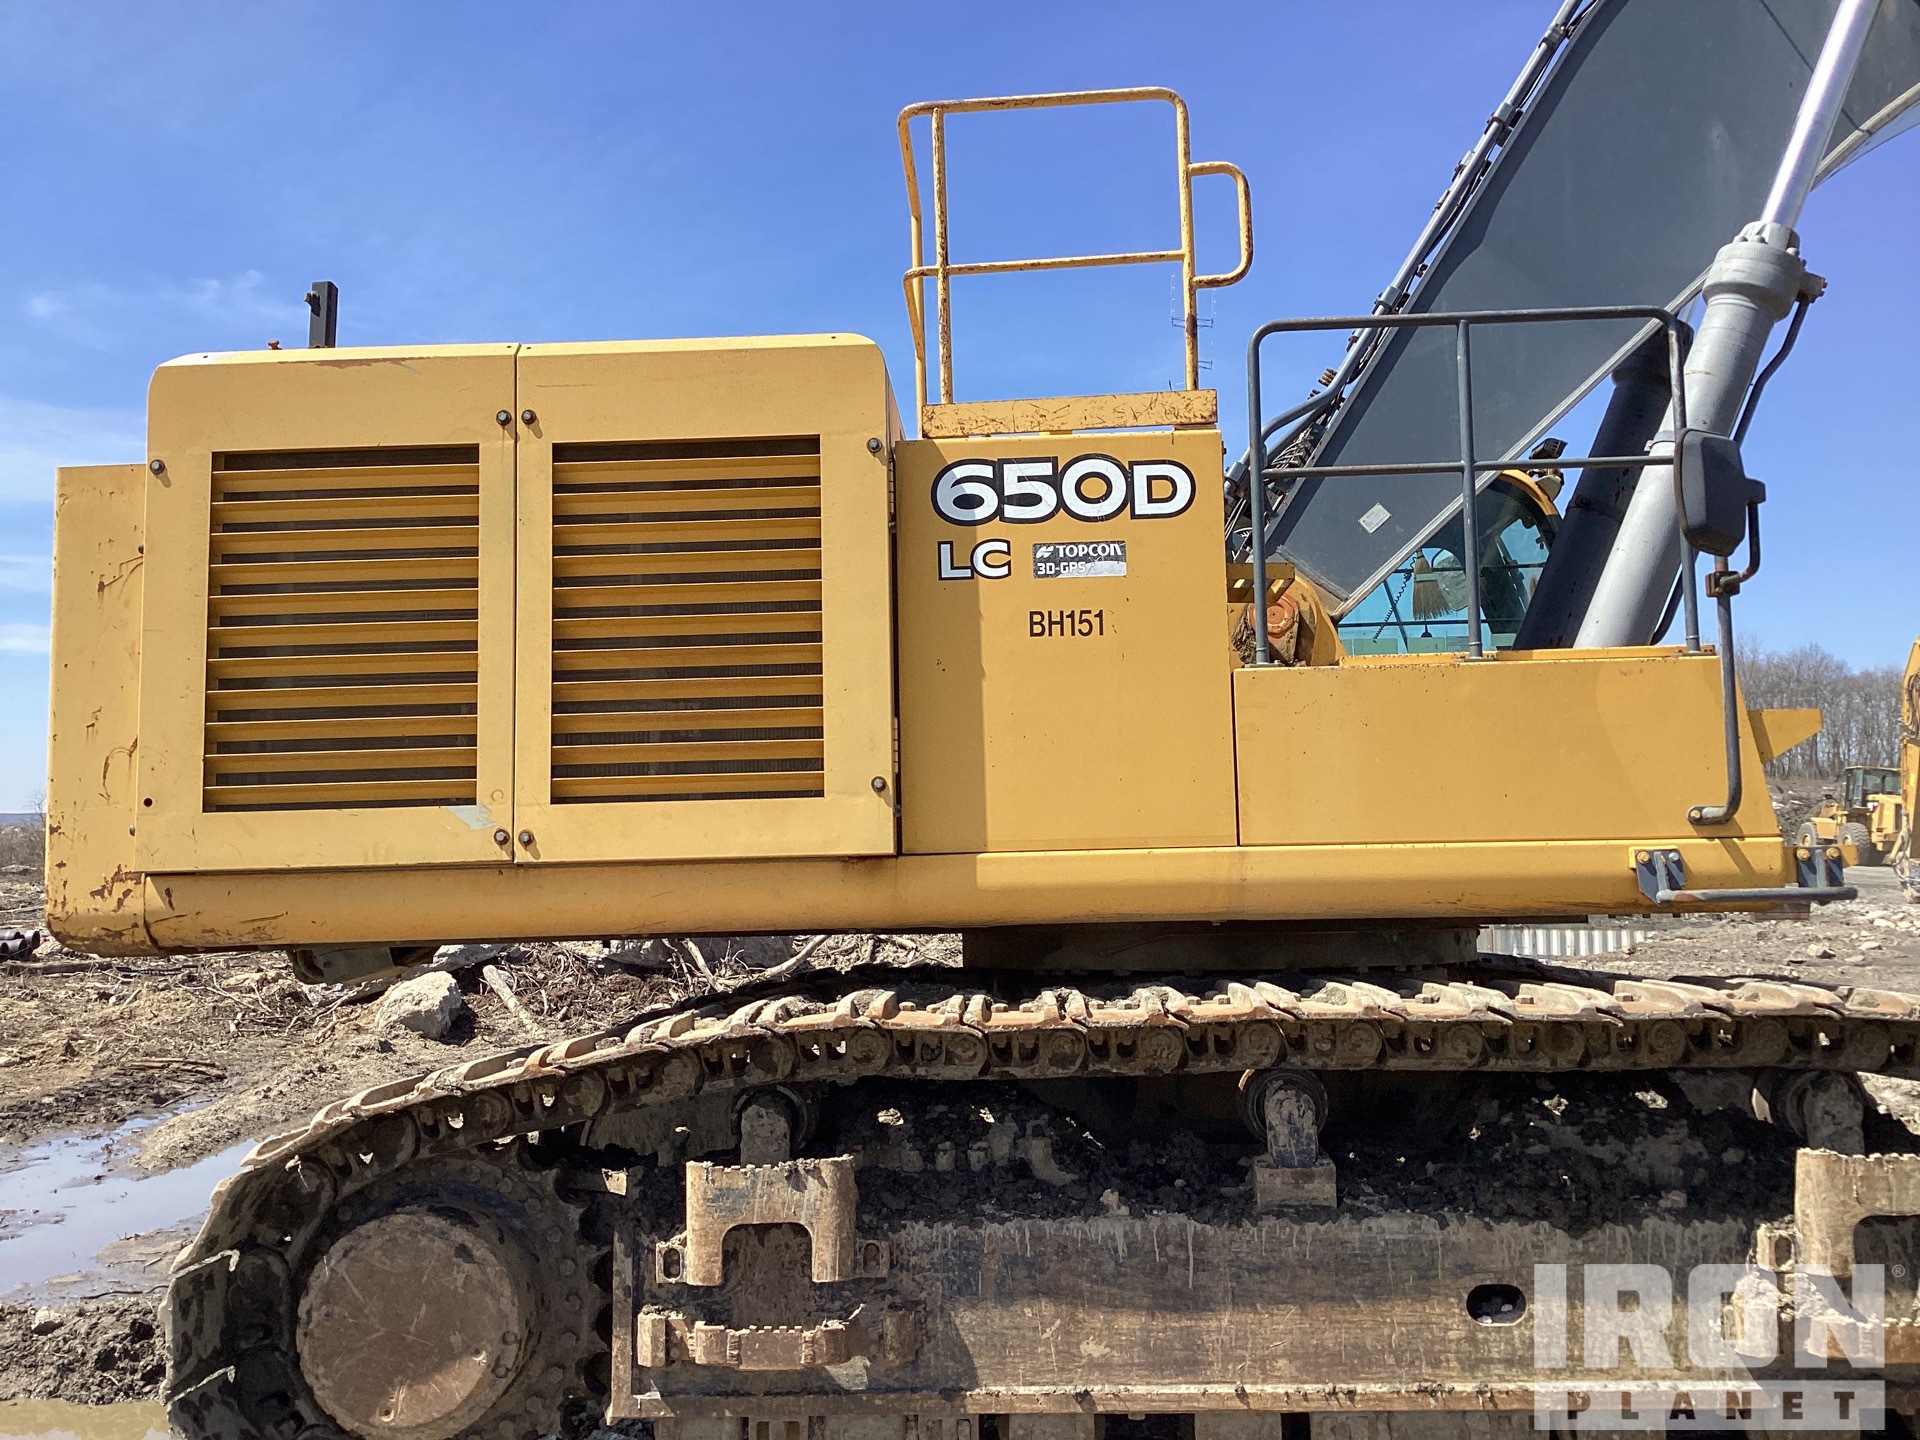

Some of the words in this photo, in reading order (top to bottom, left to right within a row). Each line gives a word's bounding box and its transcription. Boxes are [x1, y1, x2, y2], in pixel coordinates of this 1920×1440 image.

[931, 453, 1196, 526] 650D
[937, 538, 1011, 581] LC
[1056, 543, 1122, 558] TOPCON
[1037, 561, 1086, 575] 3D-GPS
[1029, 609, 1104, 637] BH151
